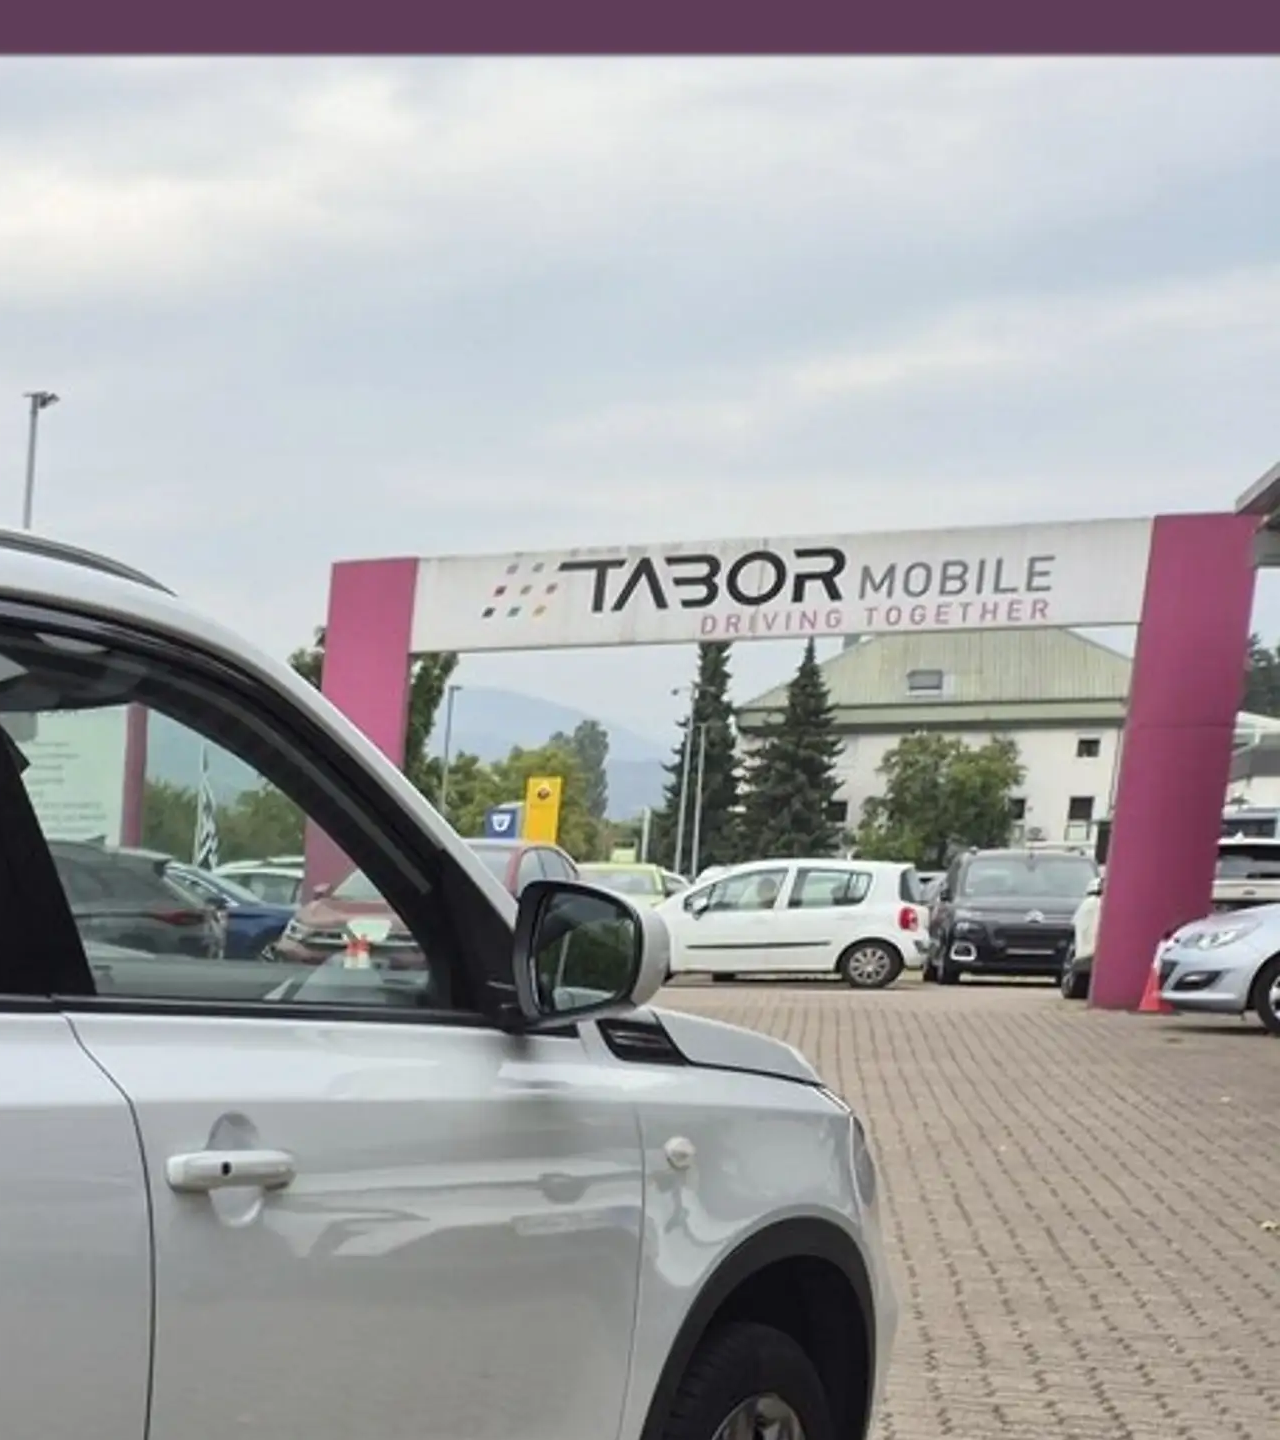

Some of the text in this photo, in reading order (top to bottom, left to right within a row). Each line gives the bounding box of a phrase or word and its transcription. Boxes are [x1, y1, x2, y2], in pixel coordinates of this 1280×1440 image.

[558, 547, 1056, 613] TABOR MOBILE
[700, 599, 1050, 636] DRIVING TOGETHER
